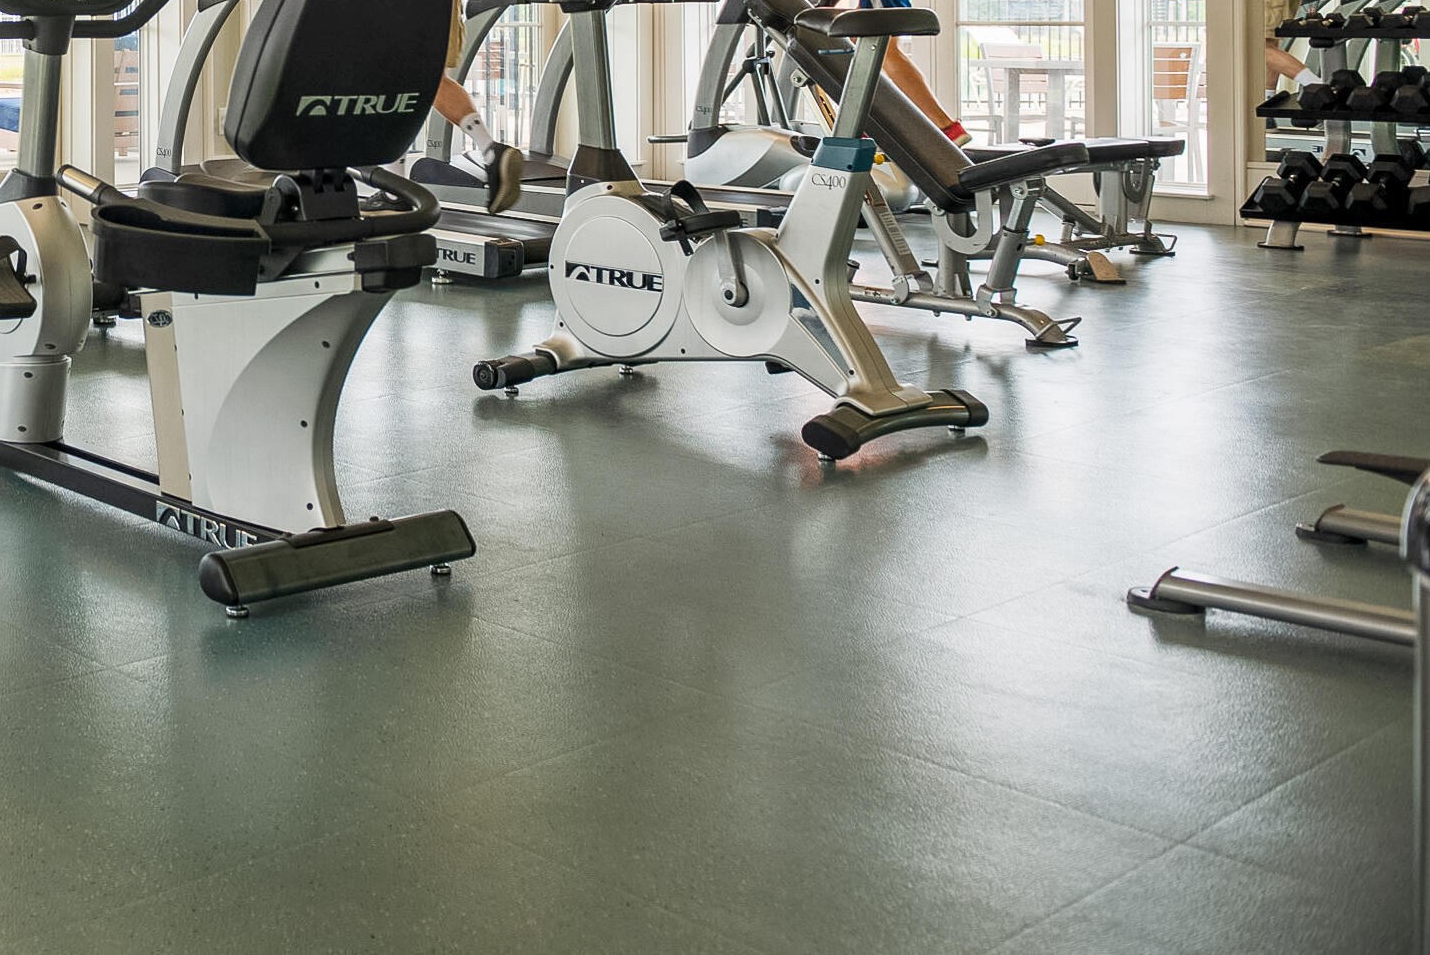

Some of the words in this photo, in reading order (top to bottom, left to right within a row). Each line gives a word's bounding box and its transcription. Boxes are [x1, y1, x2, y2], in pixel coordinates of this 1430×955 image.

[333, 92, 420, 116] TRUE
[811, 172, 847, 190] CS400
[436, 247, 476, 265] TRUE
[590, 265, 664, 293] TRUE
[180, 508, 258, 551] TRUE
